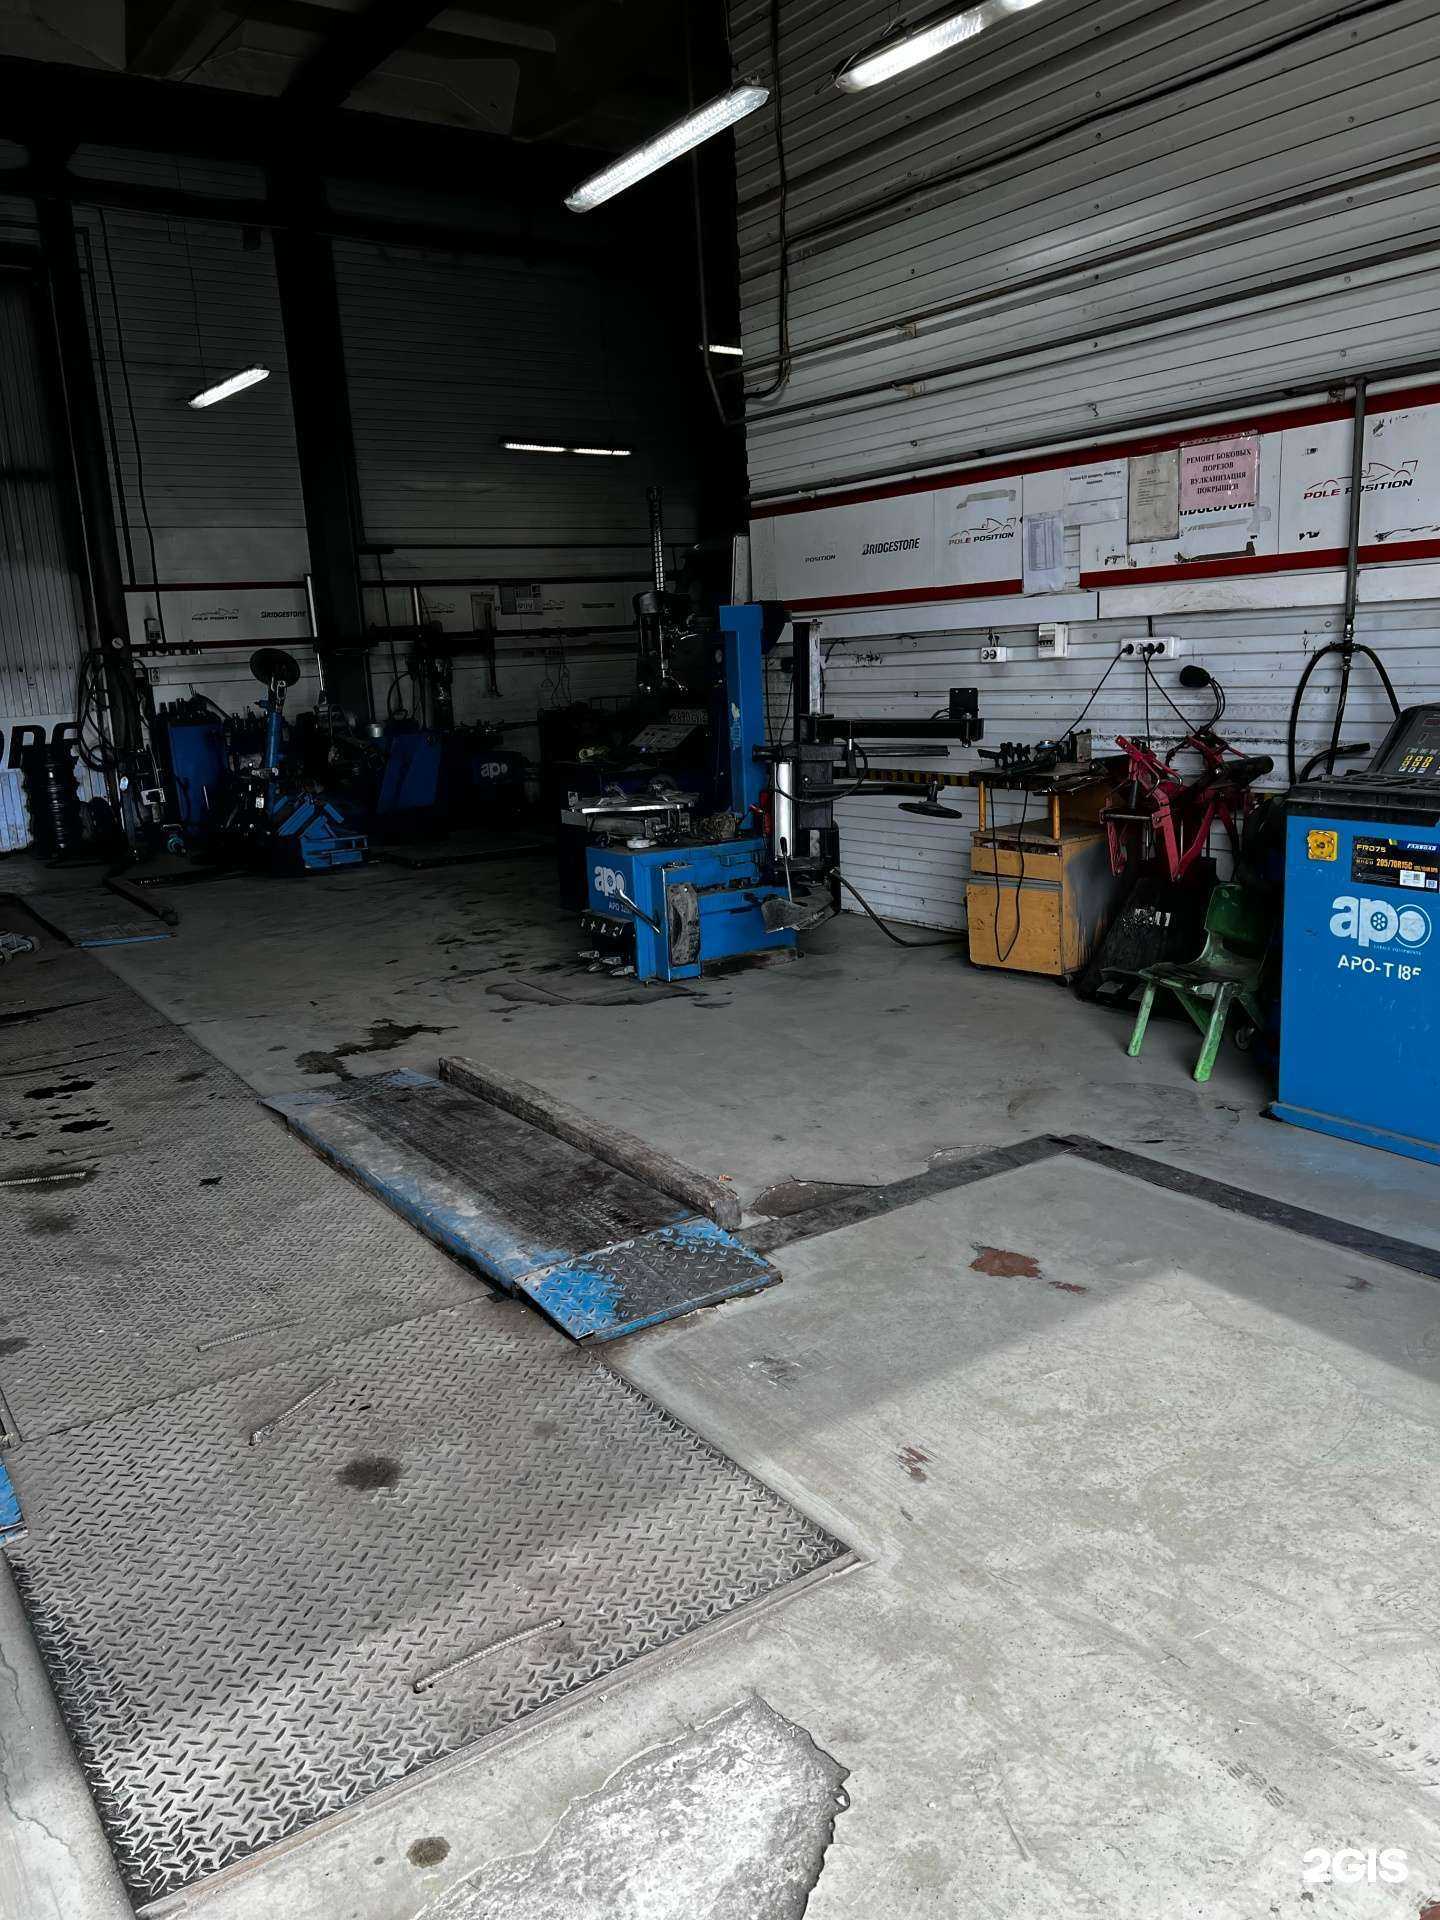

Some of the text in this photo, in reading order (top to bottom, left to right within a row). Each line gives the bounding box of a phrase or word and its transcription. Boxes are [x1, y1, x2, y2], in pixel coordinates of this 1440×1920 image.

[1186, 448, 1251, 464] РЕМОНТ БОКОВЫХ
[1202, 461, 1234, 473] ПОРЕЗОВ
[1190, 471, 1247, 485] ВУЛКАНИЗАЦИЯ
[1303, 488, 1341, 500] POLE
[948, 531, 1014, 546] POLE POSITION
[862, 537, 920, 555] BRIDGESTONE
[805, 554, 836, 563] POSITION
